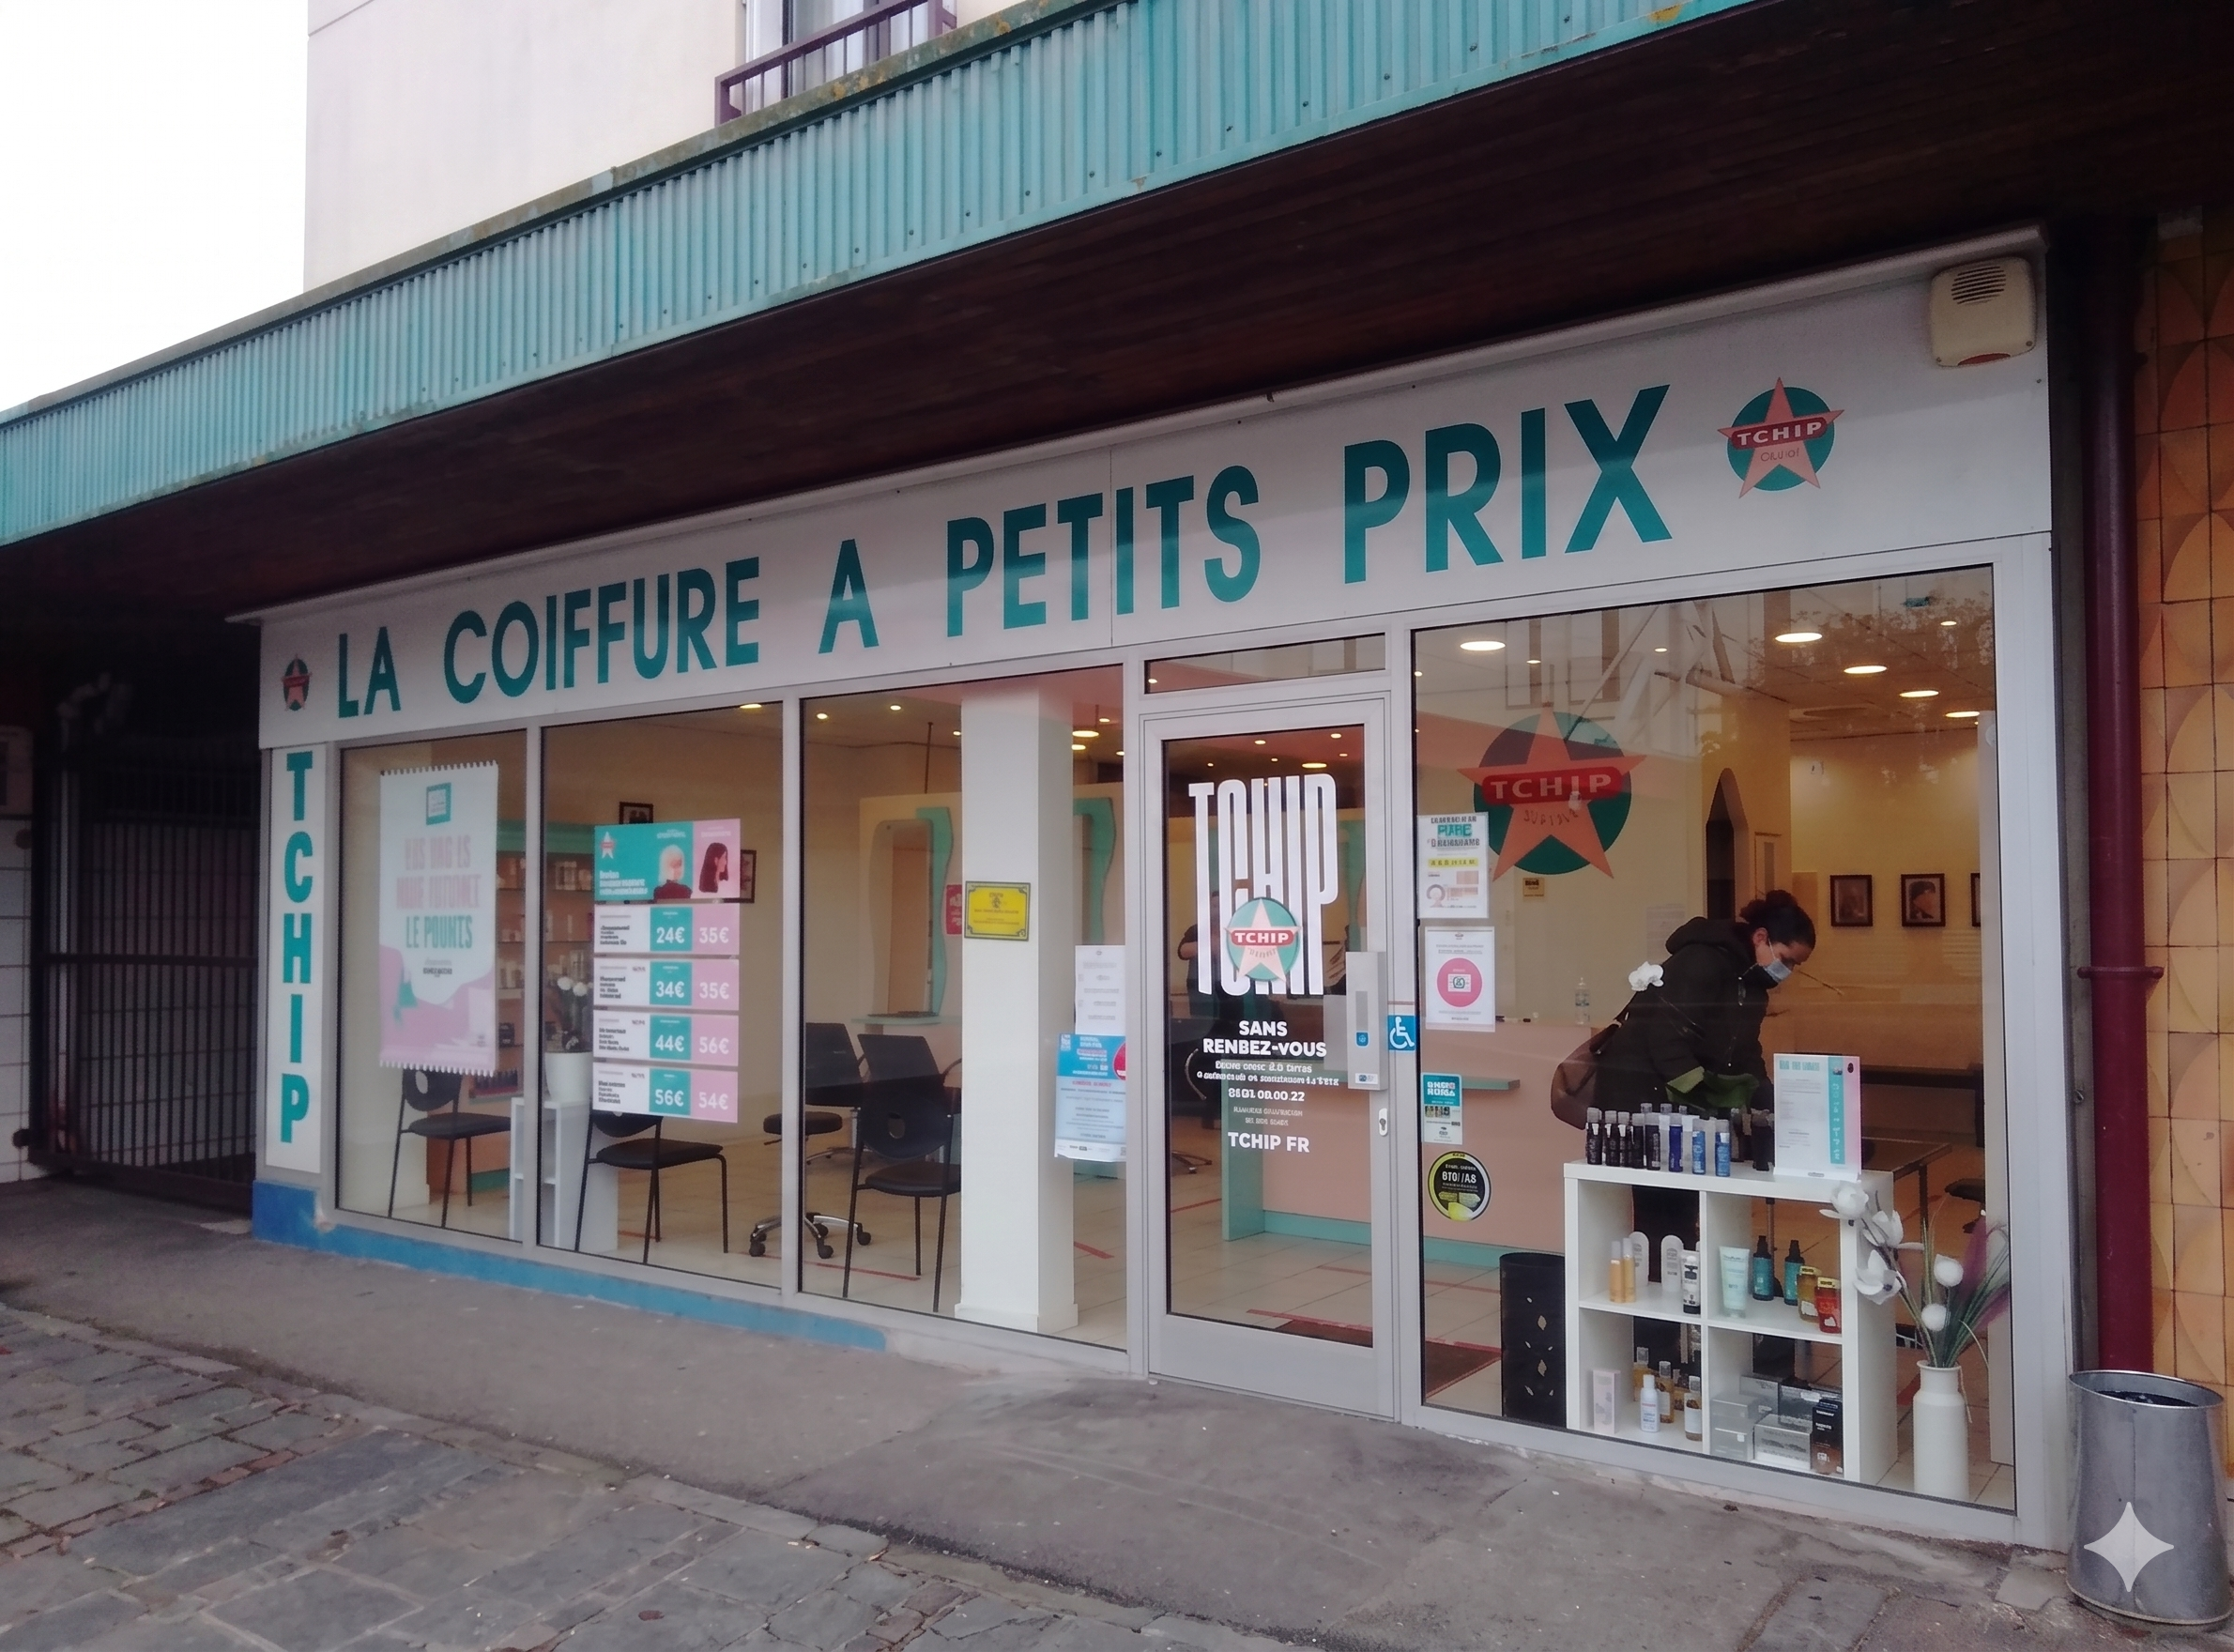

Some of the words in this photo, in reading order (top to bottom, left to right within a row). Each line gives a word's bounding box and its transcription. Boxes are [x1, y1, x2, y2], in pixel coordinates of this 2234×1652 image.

[1737, 421, 1822, 446] TCHIP
[338, 626, 402, 718] LA
[444, 556, 759, 704] COIFFURE
[818, 538, 880, 654] A
[946, 465, 1262, 638] PETITS
[1344, 384, 1673, 584] PRIX
[1490, 773, 1612, 800] TCHIP
[1188, 773, 1339, 996] TCHIP
[656, 926, 685, 944] 24€
[699, 926, 729, 944] 35€
[1234, 932, 1289, 943] TCHIP
[281, 751, 314, 1143] TCHIP
[655, 981, 685, 998] 34€
[698, 982, 729, 1000] 35€
[1239, 1020, 1288, 1036] SANS
[655, 1034, 685, 1052] 44€
[698, 1036, 729, 1055] 56€
[655, 1089, 684, 1107] 56€
[698, 1092, 728, 1110] 54€
[1228, 1131, 1281, 1150] TCHIP
[1286, 1136, 1310, 1153] FR
